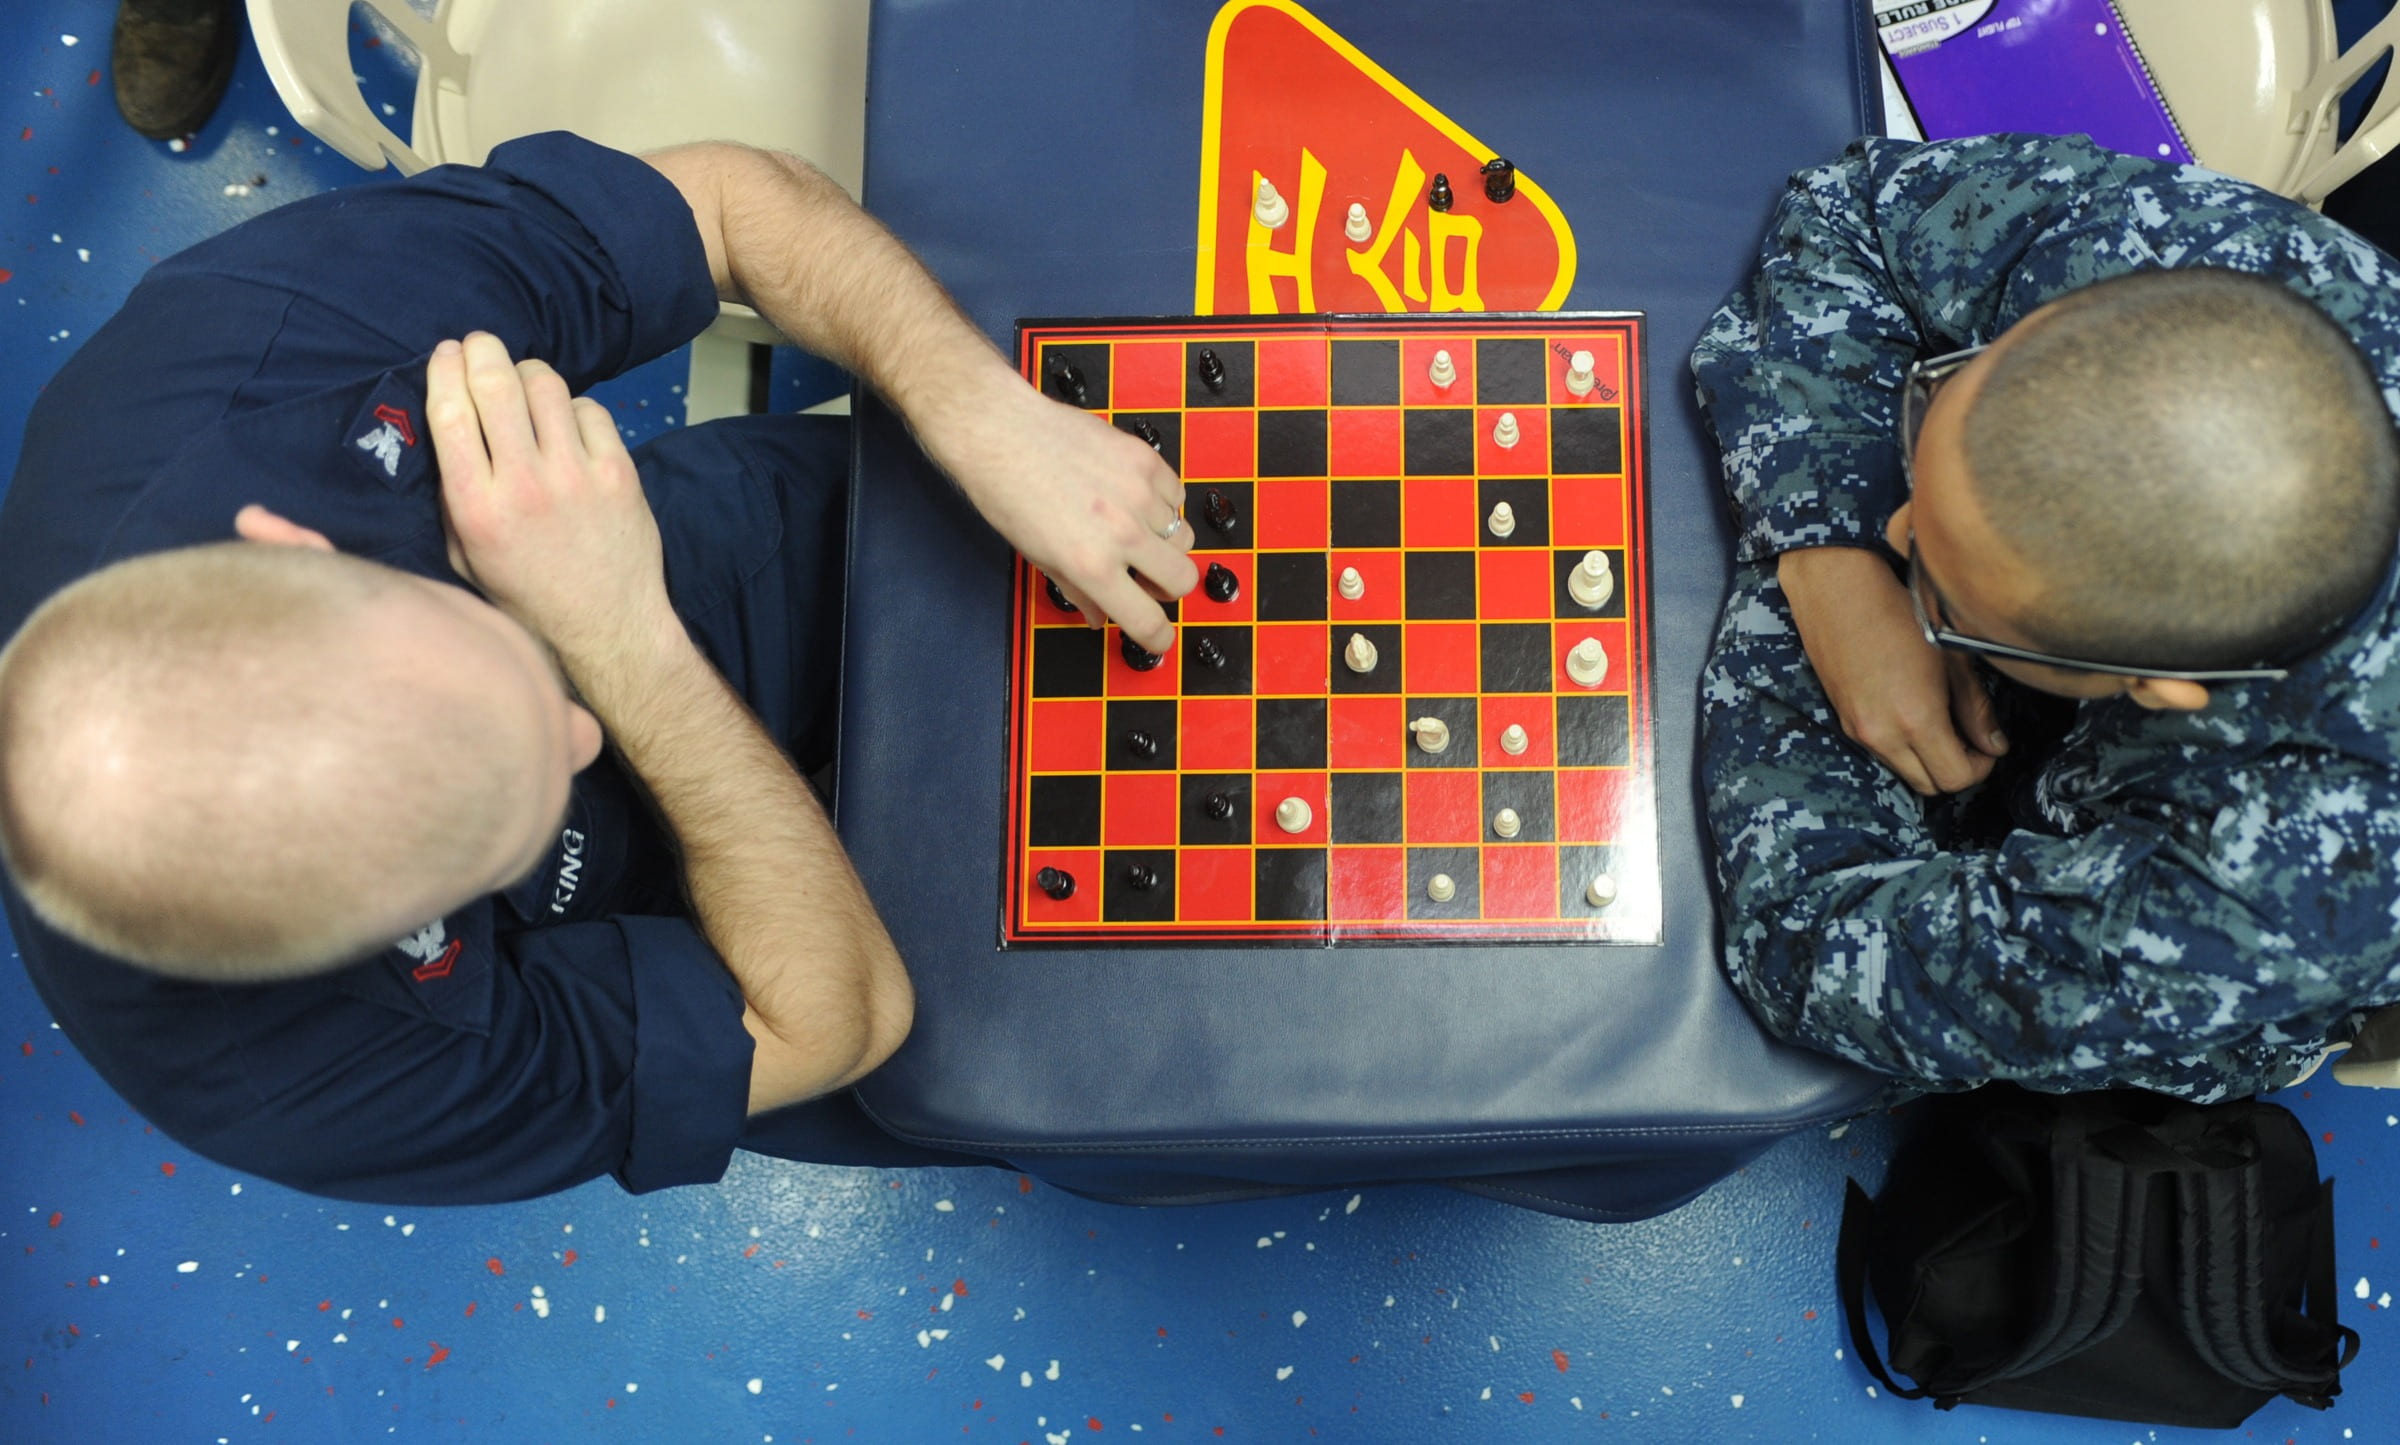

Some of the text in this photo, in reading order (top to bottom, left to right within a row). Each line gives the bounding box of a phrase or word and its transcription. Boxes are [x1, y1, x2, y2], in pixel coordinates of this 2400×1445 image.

[1877, 1, 1929, 26] RULE
[1952, 11, 1961, 25] 1
[551, 828, 585, 914] KING
